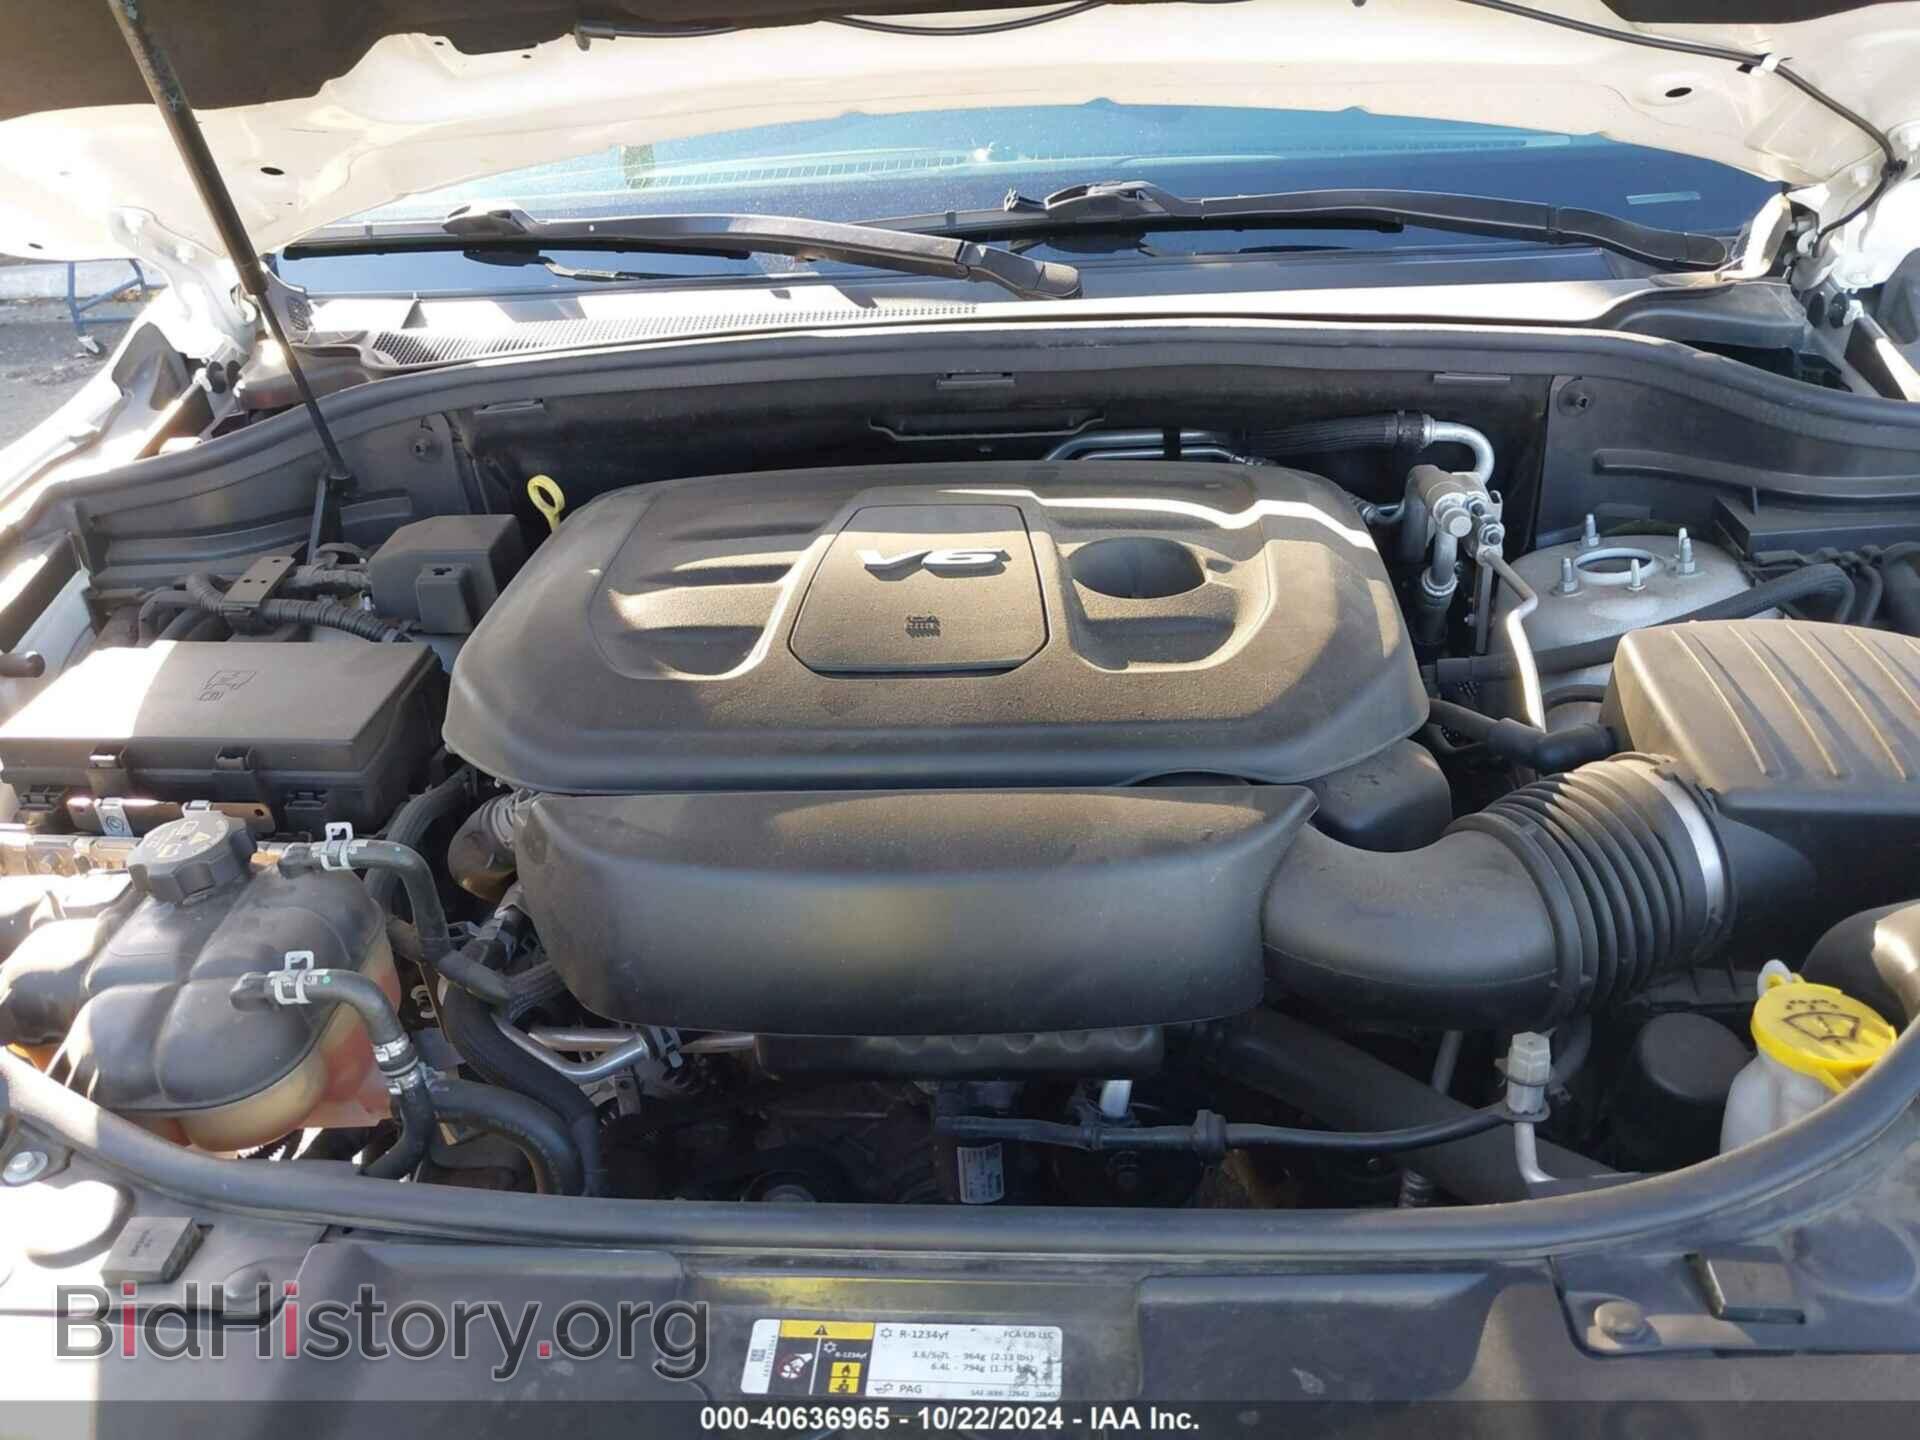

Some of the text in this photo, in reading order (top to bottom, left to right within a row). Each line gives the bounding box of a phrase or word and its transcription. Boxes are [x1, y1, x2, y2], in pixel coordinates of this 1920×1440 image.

[857, 550, 1011, 581] V6
[899, 1330, 949, 1340] R-1234yf
[899, 1385, 923, 1394] PAG
